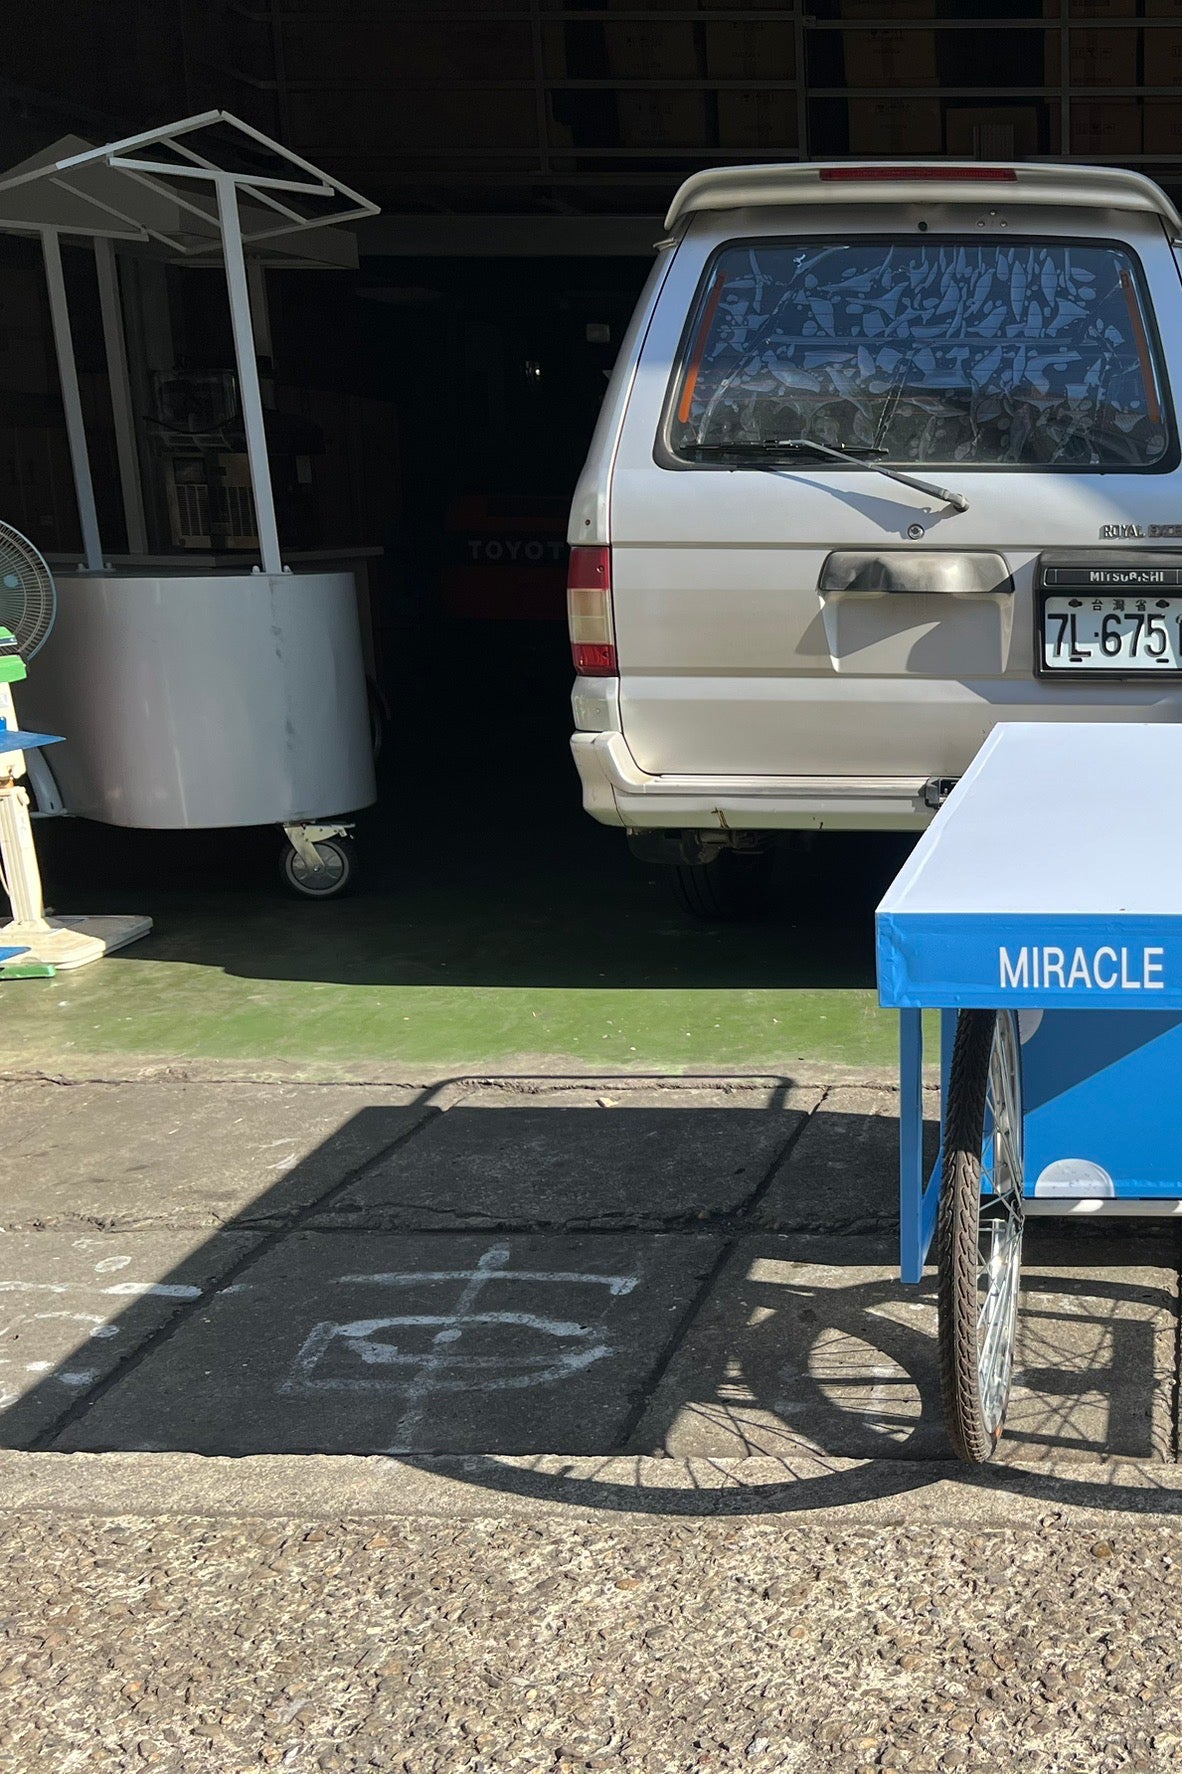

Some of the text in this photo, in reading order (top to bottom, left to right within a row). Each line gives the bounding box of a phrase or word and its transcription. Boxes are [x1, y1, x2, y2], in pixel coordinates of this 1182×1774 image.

[1104, 524, 1146, 538] ROYAL
[467, 539, 566, 560] TOYOT
[1089, 570, 1165, 583] MITSUBISHI
[998, 946, 1164, 990] MIRACLE
